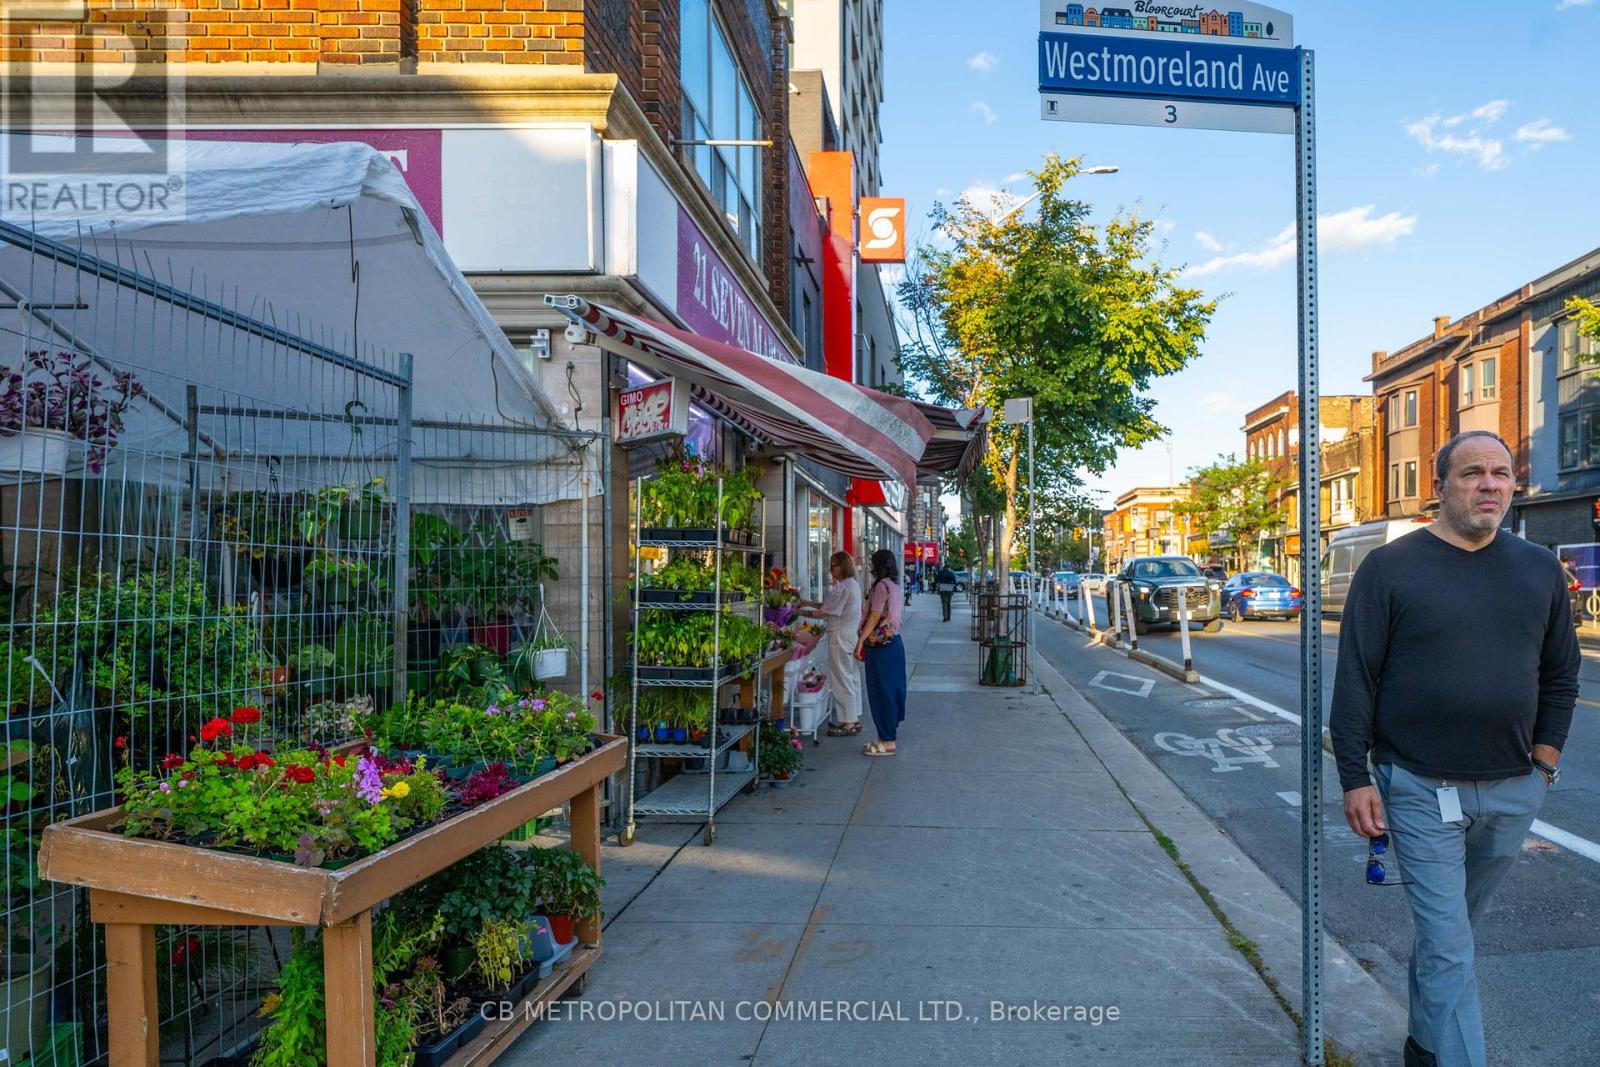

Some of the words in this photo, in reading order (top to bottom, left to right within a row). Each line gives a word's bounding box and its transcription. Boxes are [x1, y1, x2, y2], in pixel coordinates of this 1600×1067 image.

[1134, 1, 1204, 18] Bloorcourt
[1045, 40, 1243, 90] Westmoreland
[1252, 63, 1289, 93] Ave
[1164, 105, 1178, 123] 3
[693, 241, 707, 311] 21
[711, 265, 750, 350] SEVEN
[620, 390, 643, 406] GIMO
